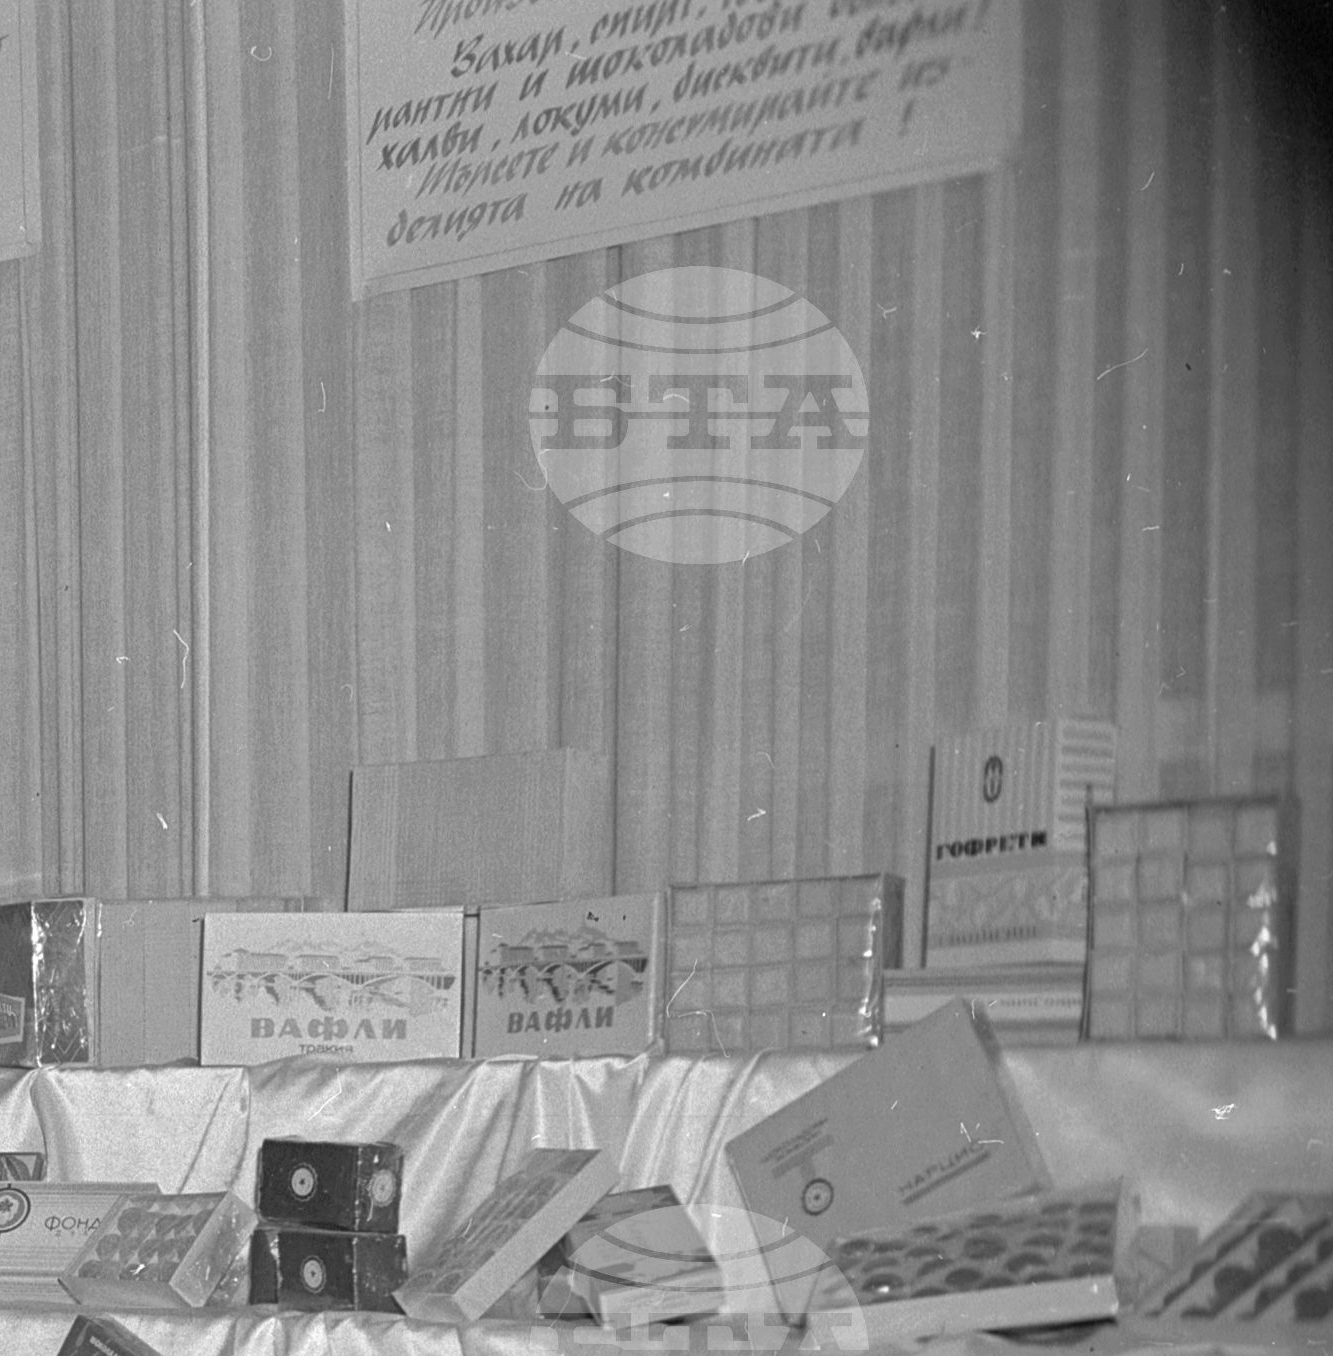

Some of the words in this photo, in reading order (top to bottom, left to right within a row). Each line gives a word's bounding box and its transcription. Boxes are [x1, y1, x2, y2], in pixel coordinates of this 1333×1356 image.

[519, 69, 549, 101] и
[566, 135, 596, 168] и
[554, 177, 603, 211] на
[936, 830, 1047, 861] ГОФРЕТИ
[250, 1016, 408, 1041] ВАФЛИ
[507, 1005, 615, 1035] ВАФЛИ
